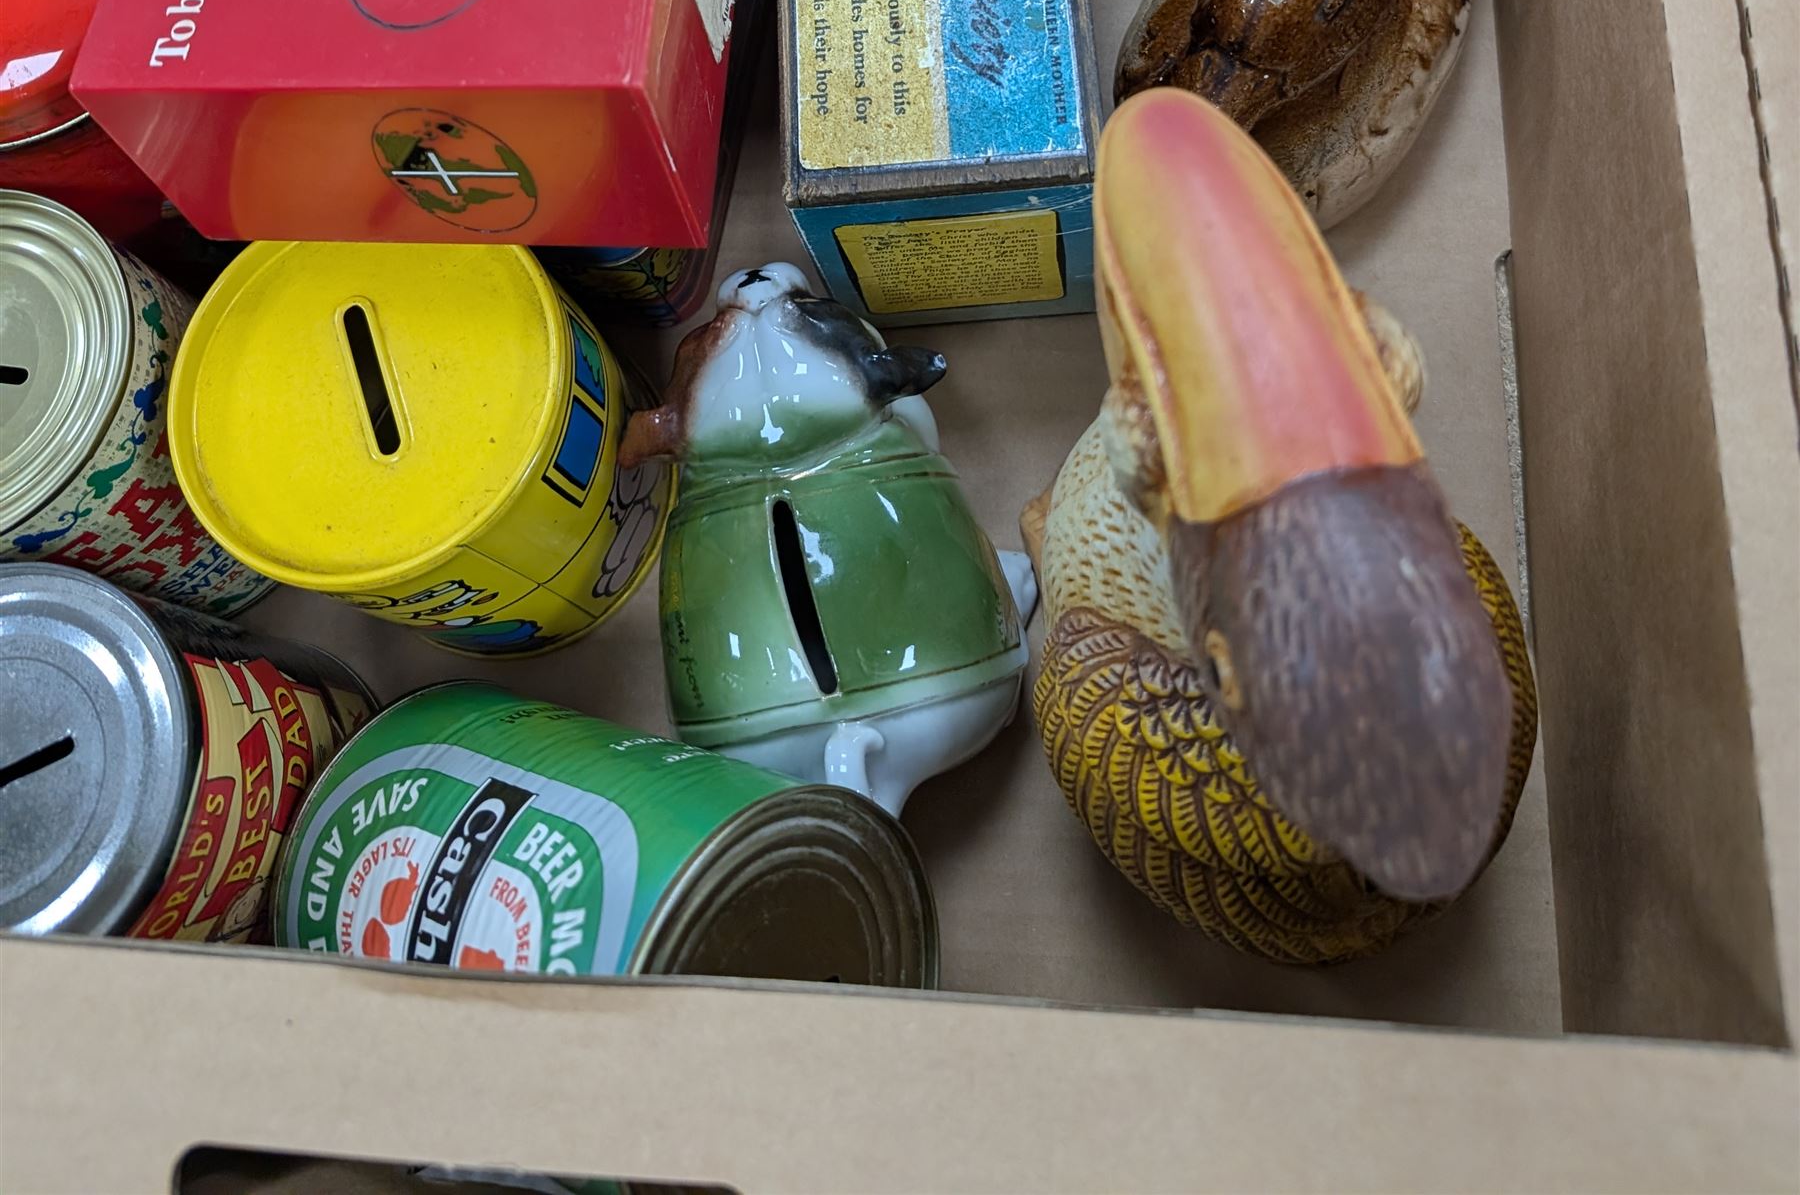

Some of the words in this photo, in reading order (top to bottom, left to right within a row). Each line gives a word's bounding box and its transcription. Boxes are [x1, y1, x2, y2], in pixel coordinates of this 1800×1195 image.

[150, 19, 195, 66] To
[813, 17, 832, 62] their
[851, 28, 869, 89] homes
[889, 53, 905, 73] to
[811, 68, 835, 117] hope
[853, 95, 872, 124] for
[891, 80, 909, 116] this
[1048, 54, 1067, 126] MOTHER
[274, 685, 309, 790] DAD
[226, 754, 273, 886] BEST
[351, 776, 429, 836] SAVE
[149, 792, 225, 938] ORLD'S
[306, 824, 345, 922] AND
[347, 841, 388, 900] LAGER
[390, 836, 416, 859] ITS
[513, 821, 583, 905] BEER
[413, 796, 507, 965] Cash
[489, 876, 530, 923] FROM
